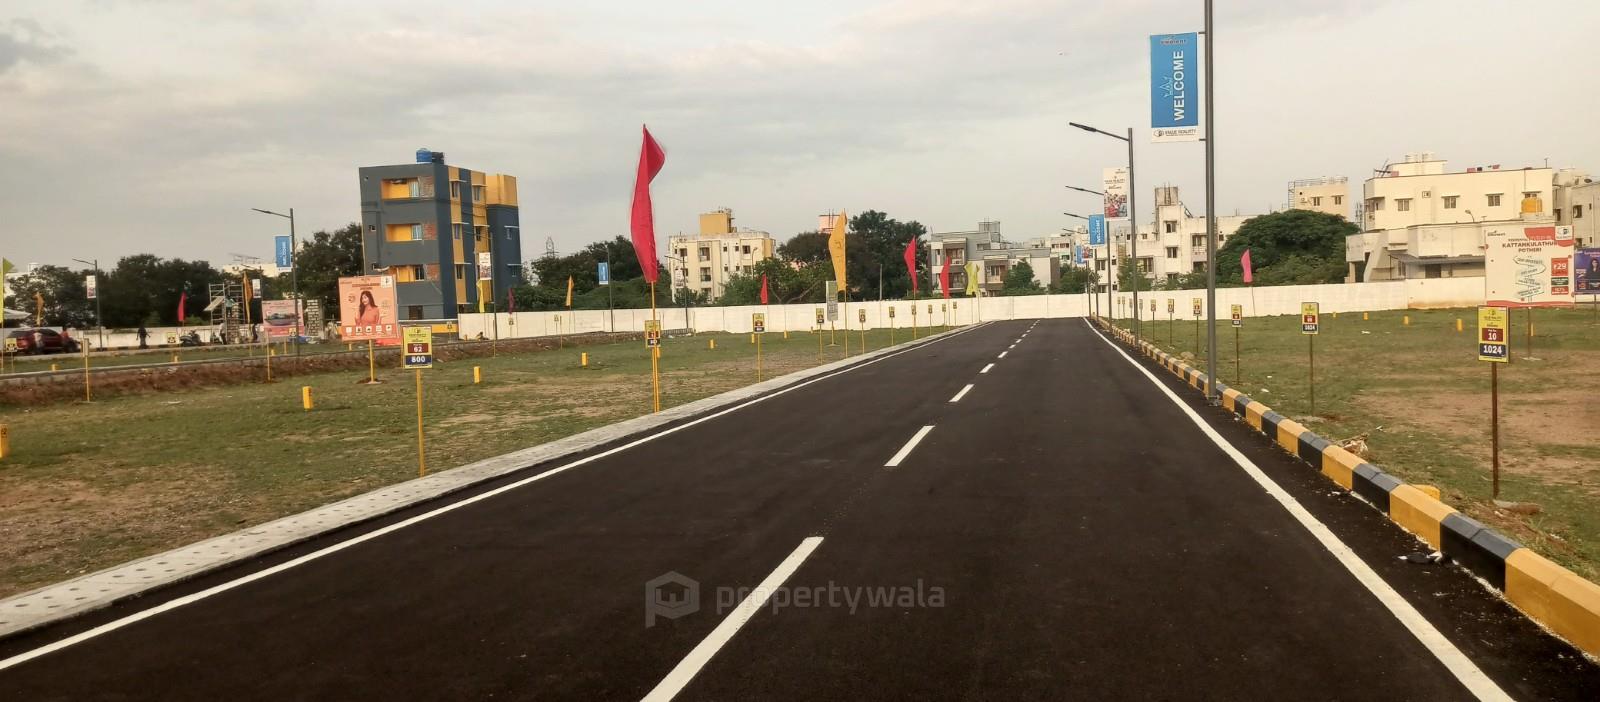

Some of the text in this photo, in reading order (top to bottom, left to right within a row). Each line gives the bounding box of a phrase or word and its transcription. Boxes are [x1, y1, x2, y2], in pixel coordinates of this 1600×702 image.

[1173, 50, 1185, 121] WELCOME
[1488, 332, 1496, 341] 10
[1483, 345, 1503, 355] 1024
